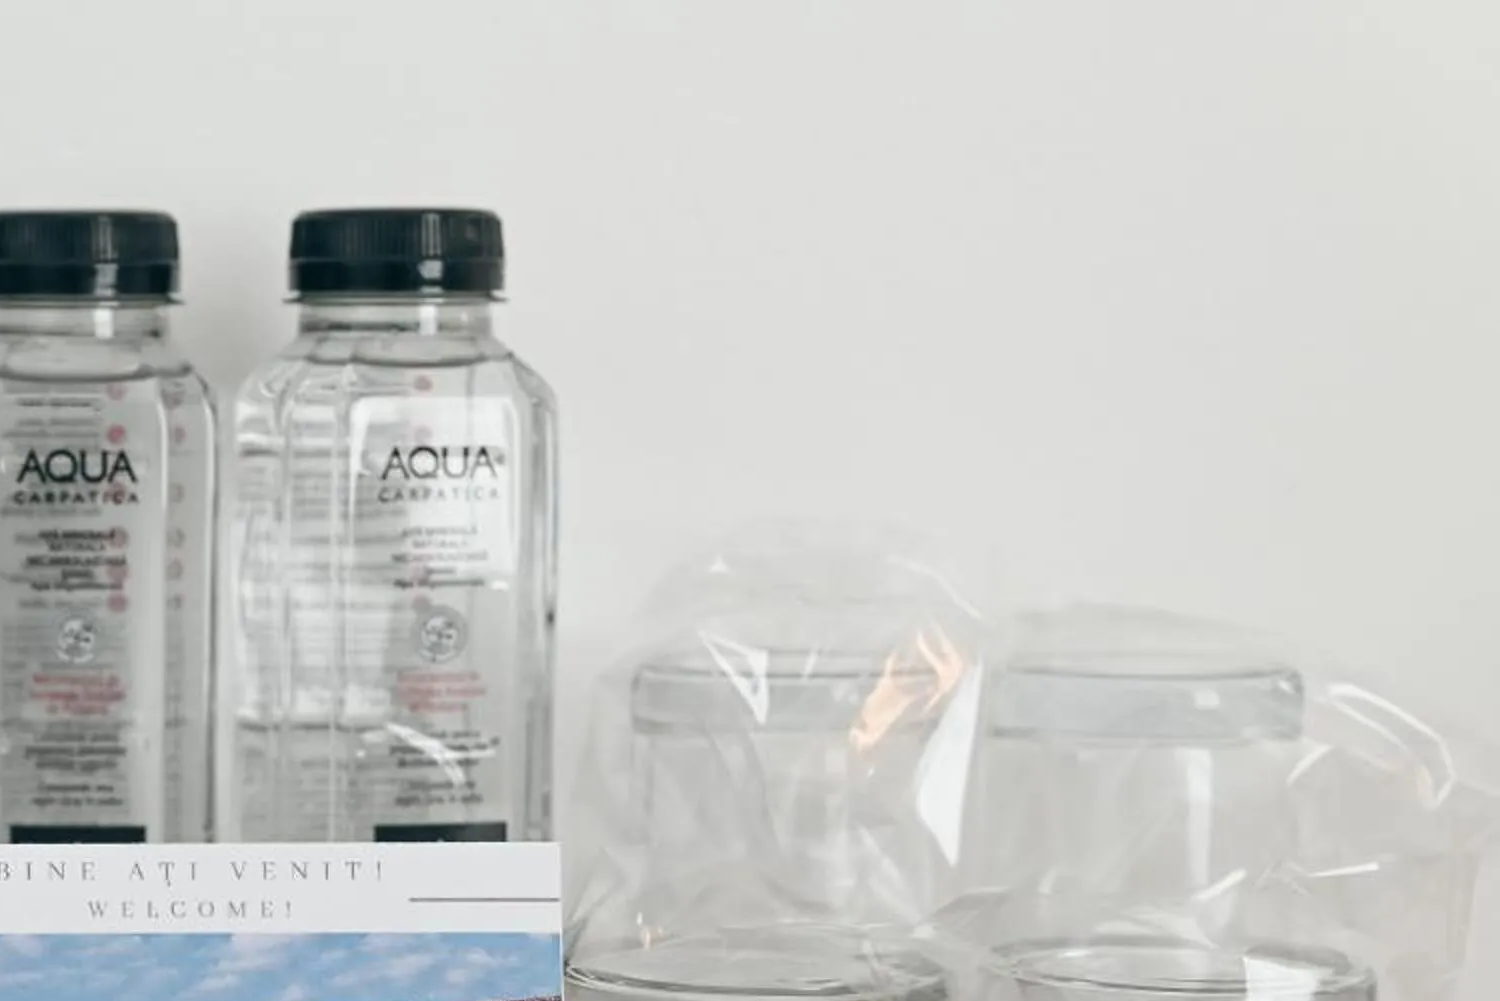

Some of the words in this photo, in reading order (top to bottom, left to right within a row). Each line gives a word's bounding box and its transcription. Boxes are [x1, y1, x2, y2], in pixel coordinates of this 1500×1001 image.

[16, 448, 138, 483] AQUA
[381, 446, 497, 480] AQUA
[230, 861, 382, 881] VENIT!
[87, 900, 292, 919] WELCOME!
